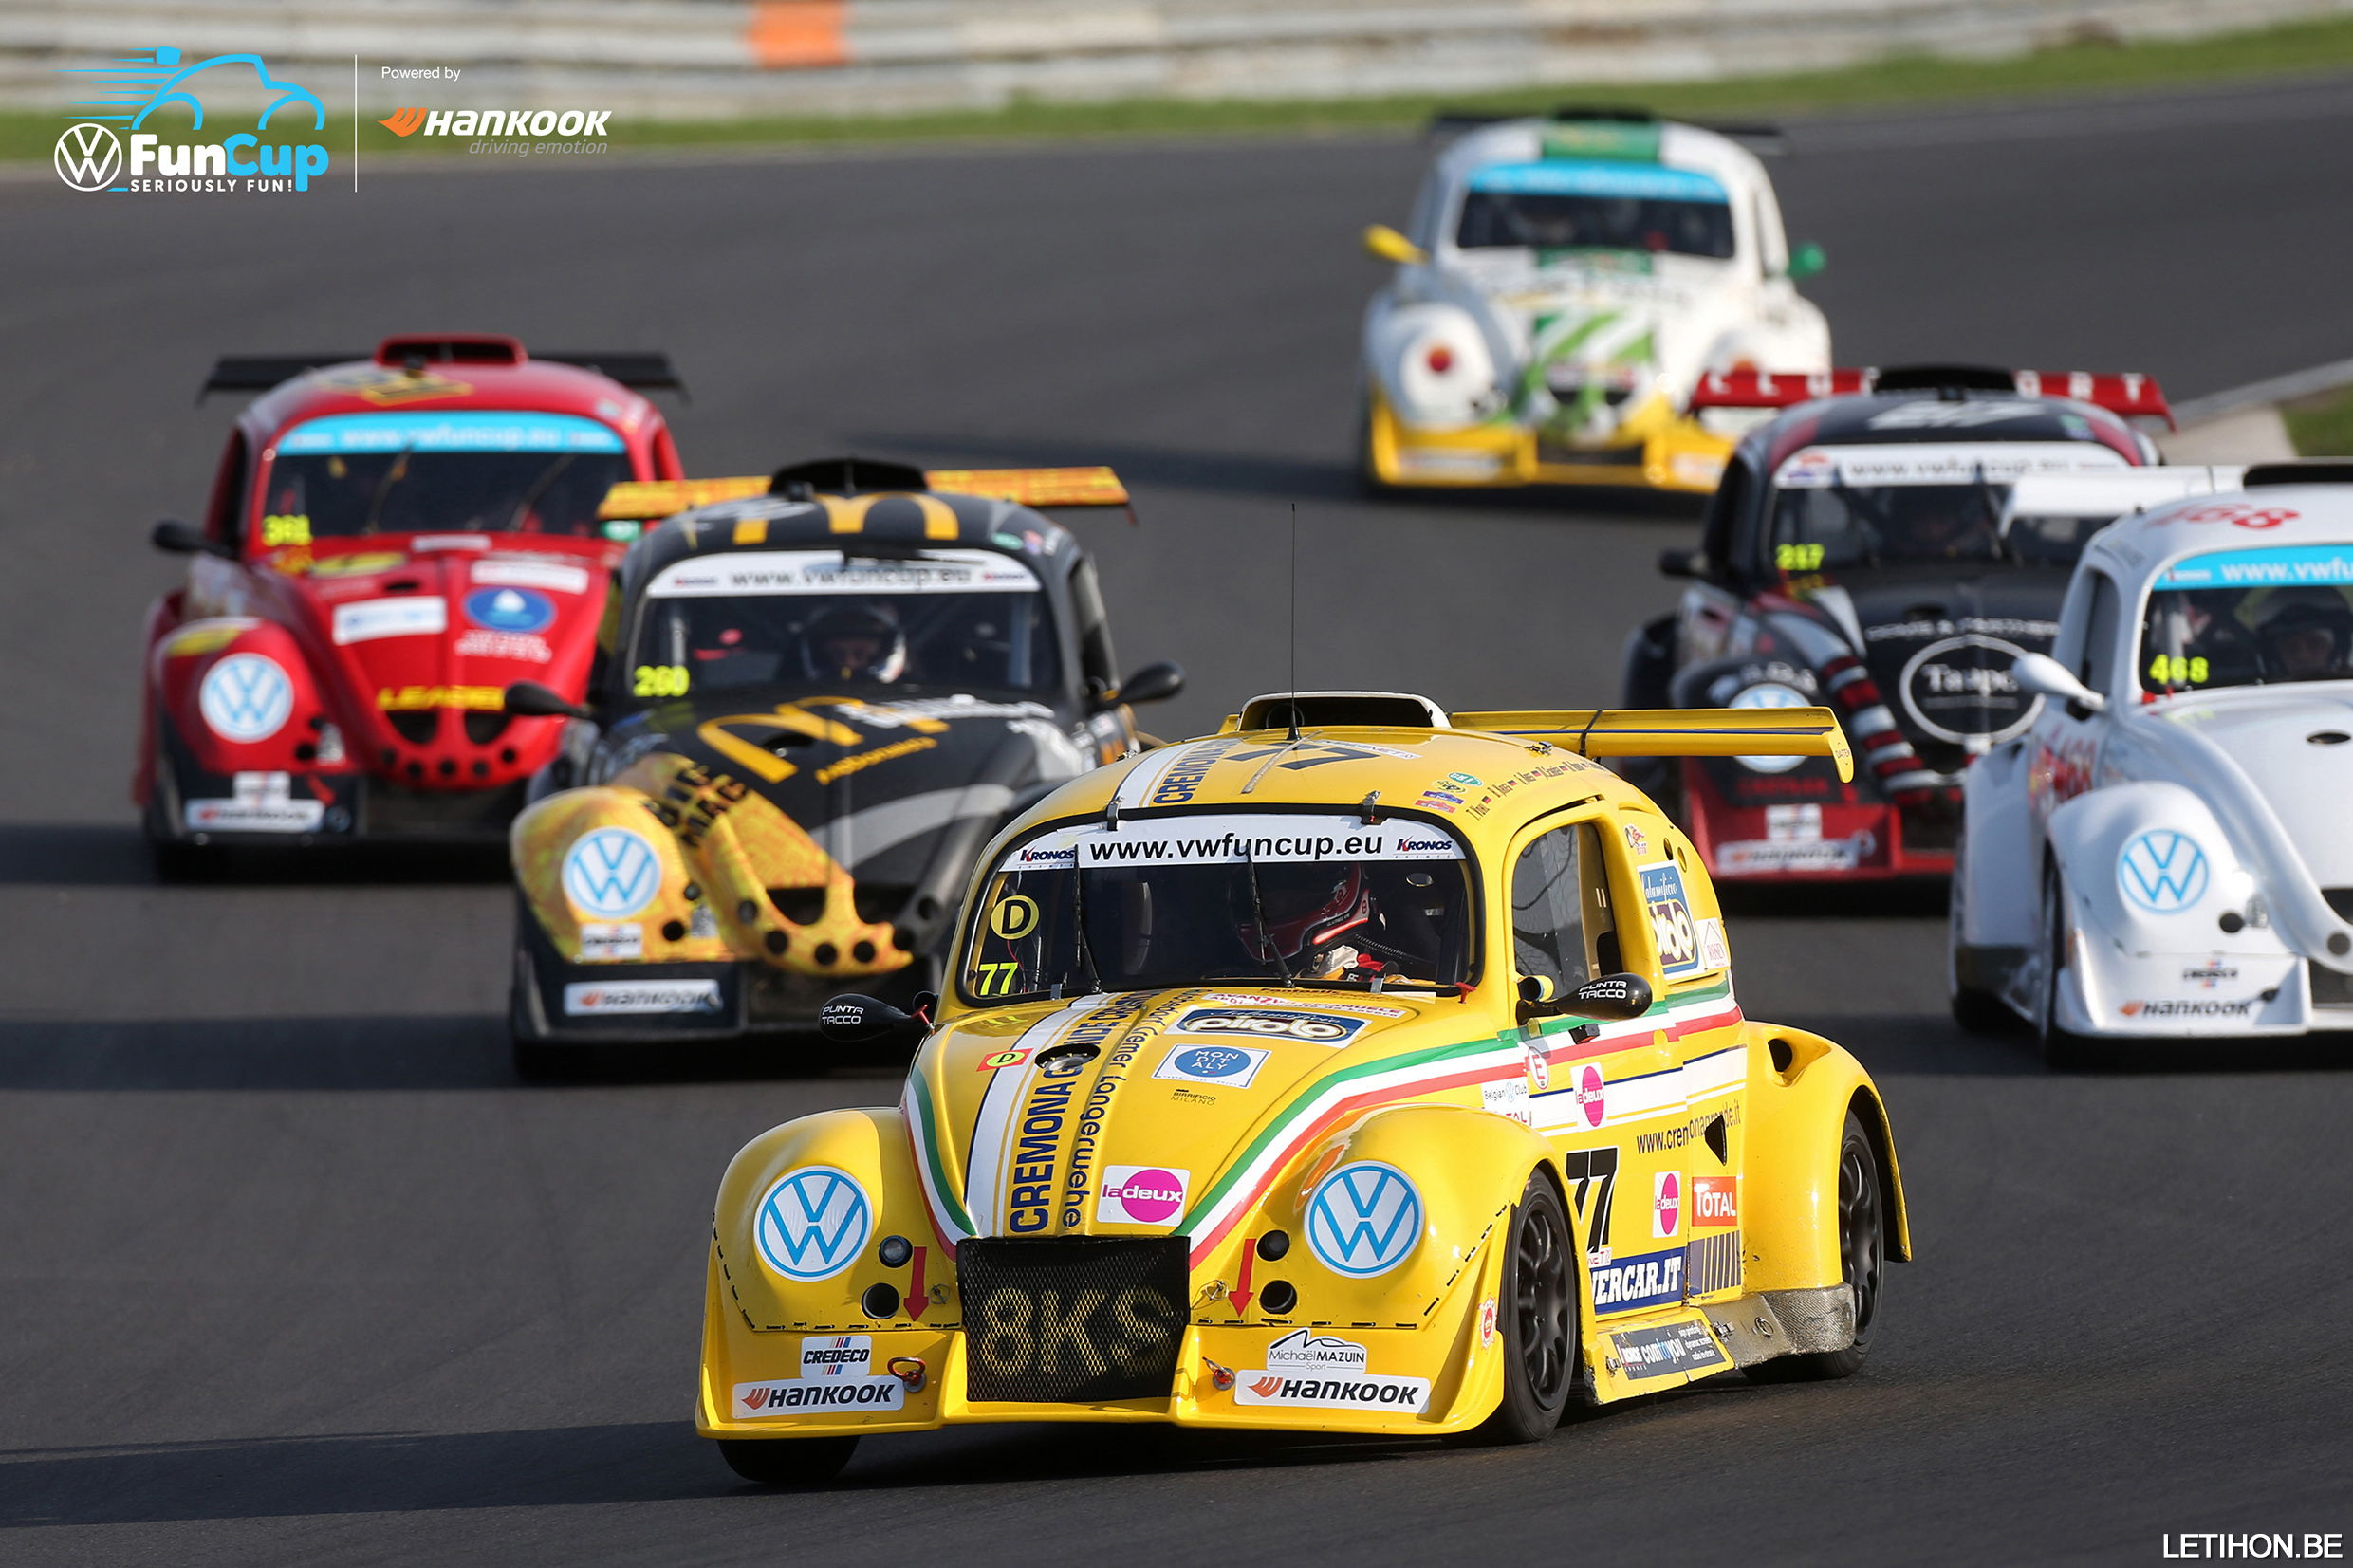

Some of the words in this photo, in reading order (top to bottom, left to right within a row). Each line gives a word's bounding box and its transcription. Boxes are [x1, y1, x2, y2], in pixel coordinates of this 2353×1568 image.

[1090, 832, 1382, 861] www.vwfuncup.eu
[1001, 900, 1032, 934] D
[979, 962, 1018, 996] 77
[1579, 980, 1627, 992] PUNTA
[1578, 988, 1627, 1000] TACCO
[822, 1005, 864, 1015] PUNTA
[822, 1015, 862, 1025] TACCO
[1195, 1050, 1239, 1060] MON
[1102, 1184, 1184, 1203] ladeux
[1693, 1184, 1737, 1218] TOTAL
[1654, 1196, 1679, 1211] ladeux
[803, 1348, 870, 1365] CREDECO
[1306, 1362, 1326, 1372] Sport
